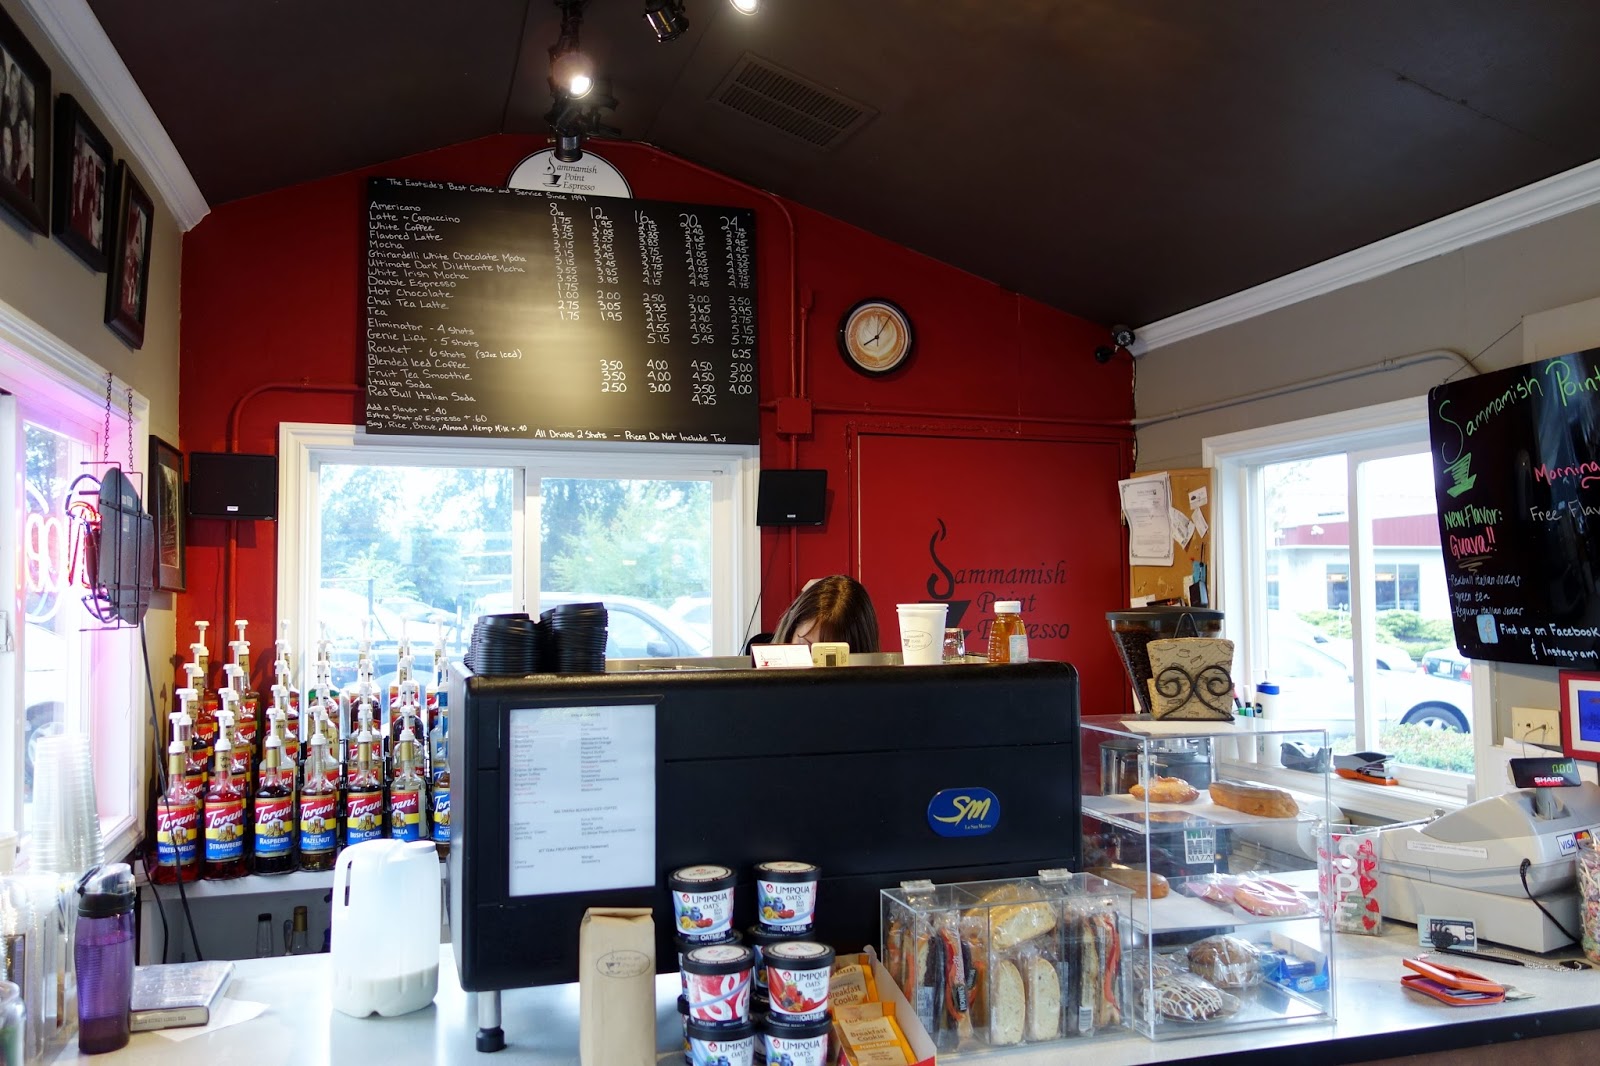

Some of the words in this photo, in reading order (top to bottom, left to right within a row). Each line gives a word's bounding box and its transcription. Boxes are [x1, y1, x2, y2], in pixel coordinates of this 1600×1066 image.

[564, 173, 584, 181] Point
[387, 178, 402, 186] The
[447, 182, 467, 191] Best
[470, 185, 494, 193] Coffee
[516, 189, 542, 197] Service
[546, 192, 567, 200] Since
[563, 182, 595, 192] Espresso
[370, 201, 421, 211] Americano
[369, 212, 398, 221] Latte
[412, 213, 460, 223] Cappuccino
[369, 222, 399, 230] White
[405, 223, 435, 232] Coffee
[370, 231, 409, 240] Flavored
[414, 233, 443, 241] Latte
[370, 241, 404, 249] Mocha
[368, 250, 419, 260] Ghirardelli
[423, 253, 449, 261] White
[453, 252, 499, 261] Chocolate
[502, 254, 527, 262] Mocha
[368, 259, 411, 268] Ultimate
[415, 261, 438, 269] Dark
[443, 262, 493, 271] Dilettante
[497, 265, 525, 273] Mocha
[368, 269, 398, 277] White
[404, 270, 429, 278] Irish
[368, 277, 406, 286] Double
[409, 279, 456, 288] Espresso
[368, 287, 390, 295] Hot
[397, 289, 453, 298] Chocolate
[597, 290, 621, 300] 2.00
[367, 297, 391, 305] Chai
[396, 299, 416, 308] Tea
[420, 301, 449, 309] Latte
[558, 300, 579, 310] 2.75
[598, 301, 621, 310] 3.05
[368, 307, 388, 316] Tea
[560, 311, 580, 320] 1.75
[601, 311, 623, 321] 1.95
[368, 318, 423, 331] Eliminator
[437, 324, 445, 334] 4
[367, 330, 399, 340] Genie
[403, 334, 427, 342] Lift
[441, 337, 450, 345] 5
[368, 341, 411, 353] Rocket
[429, 348, 437, 357] 6
[368, 354, 408, 366] Blended
[411, 356, 431, 367] Iced
[435, 360, 470, 369] Coffee
[368, 368, 398, 377] Fruit
[400, 369, 419, 379] Tea
[423, 370, 472, 380] Smoothie
[368, 378, 402, 387] Italian
[406, 380, 432, 389] Soda
[368, 385, 388, 396] Red
[390, 388, 411, 398] Bull
[416, 391, 448, 401] Italian
[451, 392, 476, 402] Soda
[392, 405, 418, 413] Flavor
[1439, 376, 1544, 464] Sammamish
[472, 425, 492, 433] Hemp
[535, 430, 546, 438] All
[549, 430, 574, 439] Drinks
[577, 430, 583, 439] 2
[585, 431, 607, 439] Shots
[625, 431, 647, 441] Prices
[649, 432, 660, 441] Do
[662, 433, 677, 441] Not
[680, 432, 708, 442] Include
[711, 434, 727, 442] Tax
[1444, 507, 1465, 530] New
[1530, 506, 1562, 521] Free
[1450, 527, 1497, 559] Guava!!
[927, 530, 1067, 599] Sammamish
[1500, 623, 1516, 635] Find
[1520, 626, 1531, 635] us
[1535, 626, 1547, 636] on
[1549, 623, 1600, 637] Facebook
[1542, 642, 1598, 661] Instagram
[301, 799, 335, 820] Torani
[348, 799, 382, 818] Torani
[206, 809, 242, 830] Torani
[256, 805, 292, 825] Torani
[1561, 841, 1575, 850] VISA
[775, 886, 810, 894] UMPQUA
[692, 892, 728, 904] UMPQUA
[793, 971, 828, 982] UMPQUA
[834, 994, 858, 1006] Cookie
[850, 1028, 887, 1037] Breakfast
[719, 1040, 754, 1051] UMPQUA
[782, 1040, 821, 1051] UMPQUA
